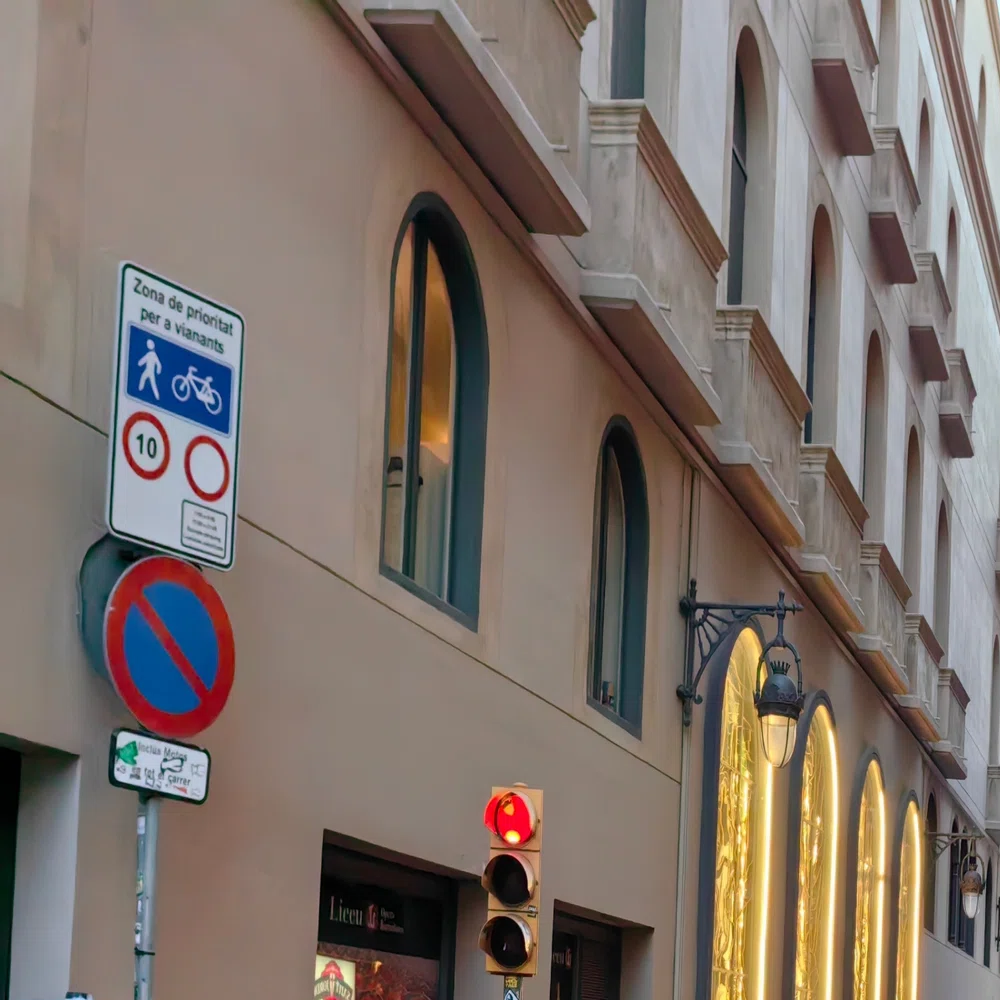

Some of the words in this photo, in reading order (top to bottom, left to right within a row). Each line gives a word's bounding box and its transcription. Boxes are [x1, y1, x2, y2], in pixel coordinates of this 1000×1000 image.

[133, 277, 165, 305] Zona
[168, 296, 183, 313] de
[187, 305, 234, 336] prioritat
[140, 308, 161, 325] per
[164, 319, 171, 331] a
[175, 322, 225, 355] vianants
[136, 433, 157, 459] 10
